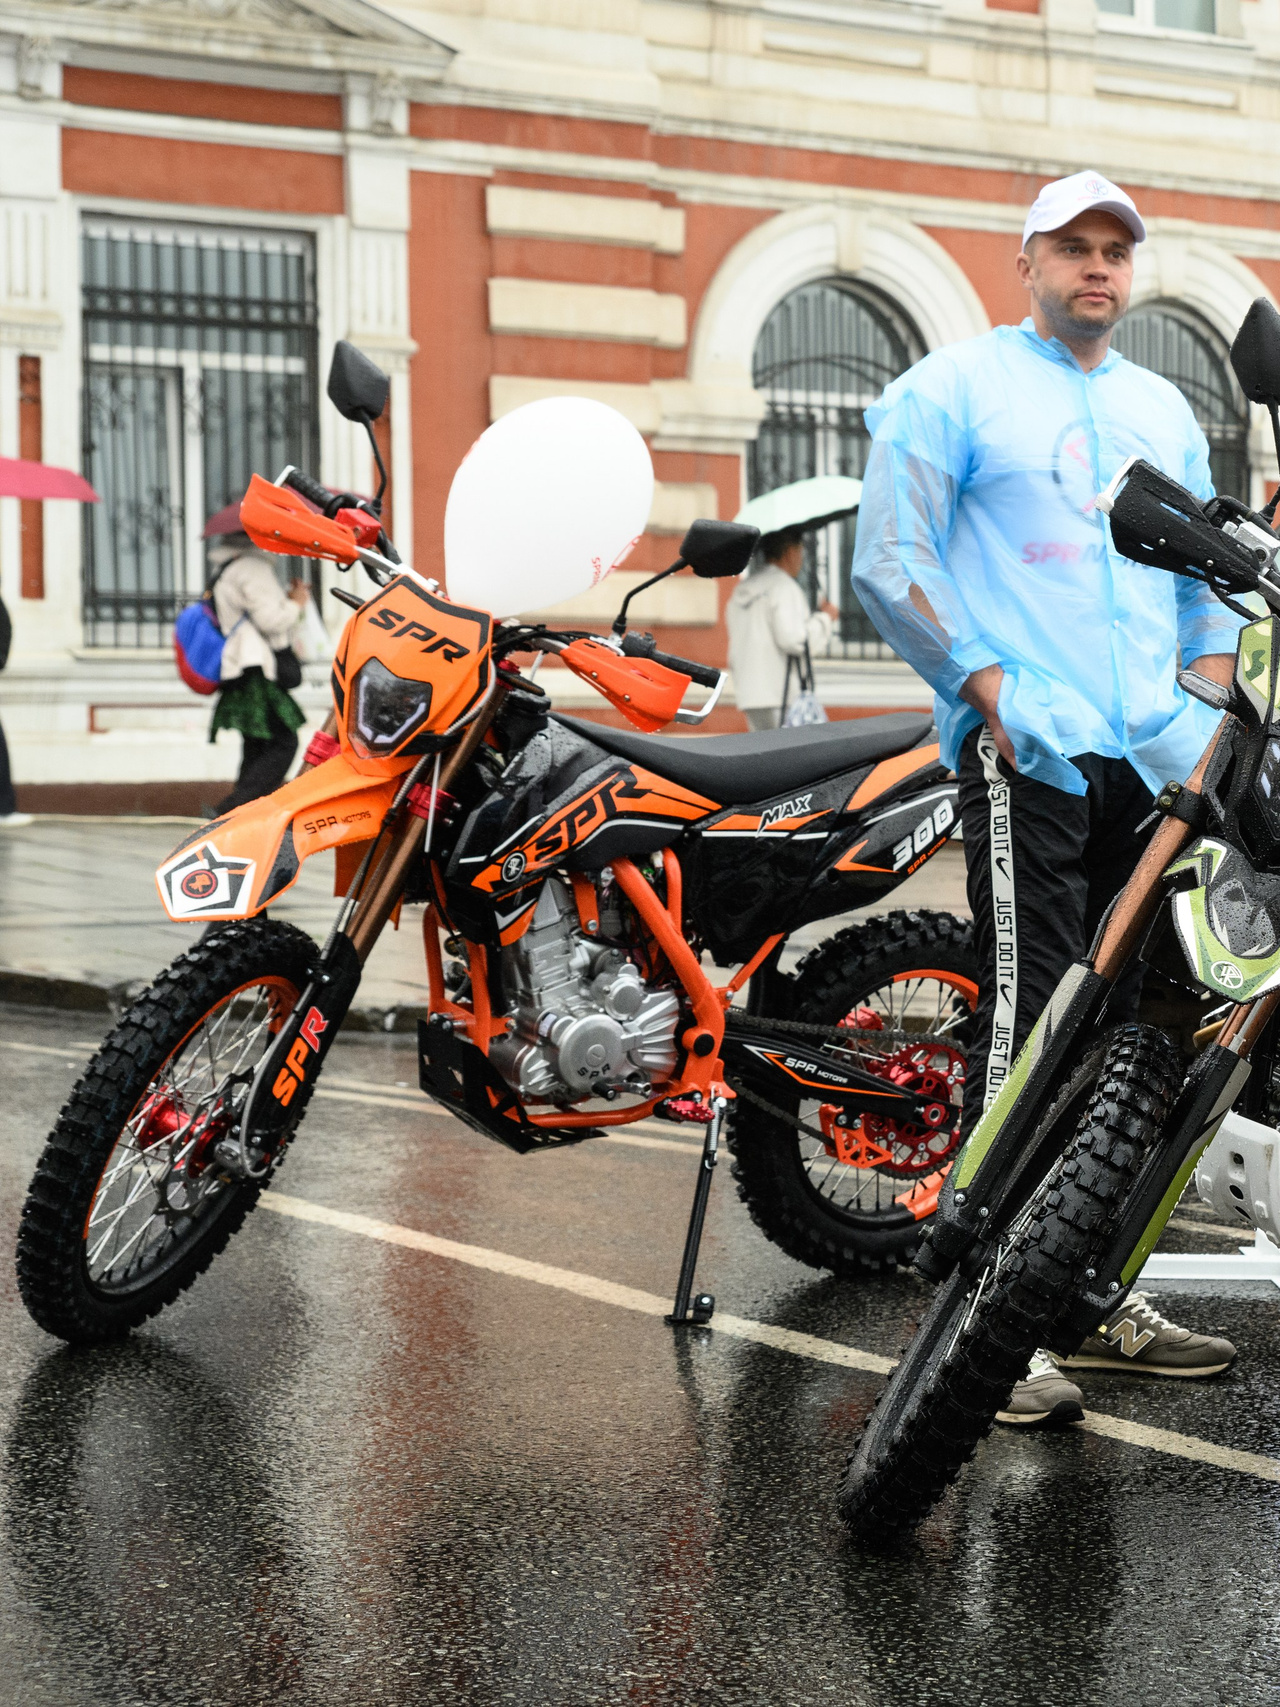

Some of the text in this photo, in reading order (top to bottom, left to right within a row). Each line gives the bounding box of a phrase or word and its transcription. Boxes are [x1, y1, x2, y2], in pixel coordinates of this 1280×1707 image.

[368, 608, 471, 664] SPR
[531, 763, 653, 864] SPR
[754, 793, 812, 838] MAX
[893, 798, 954, 872] 300
[989, 778, 1010, 853] JUST DO IT
[996, 896, 1014, 981] JUST DO IT
[272, 1005, 330, 1108] SPR
[784, 1057, 818, 1074] SPR
[992, 1021, 1011, 1062] JUST
